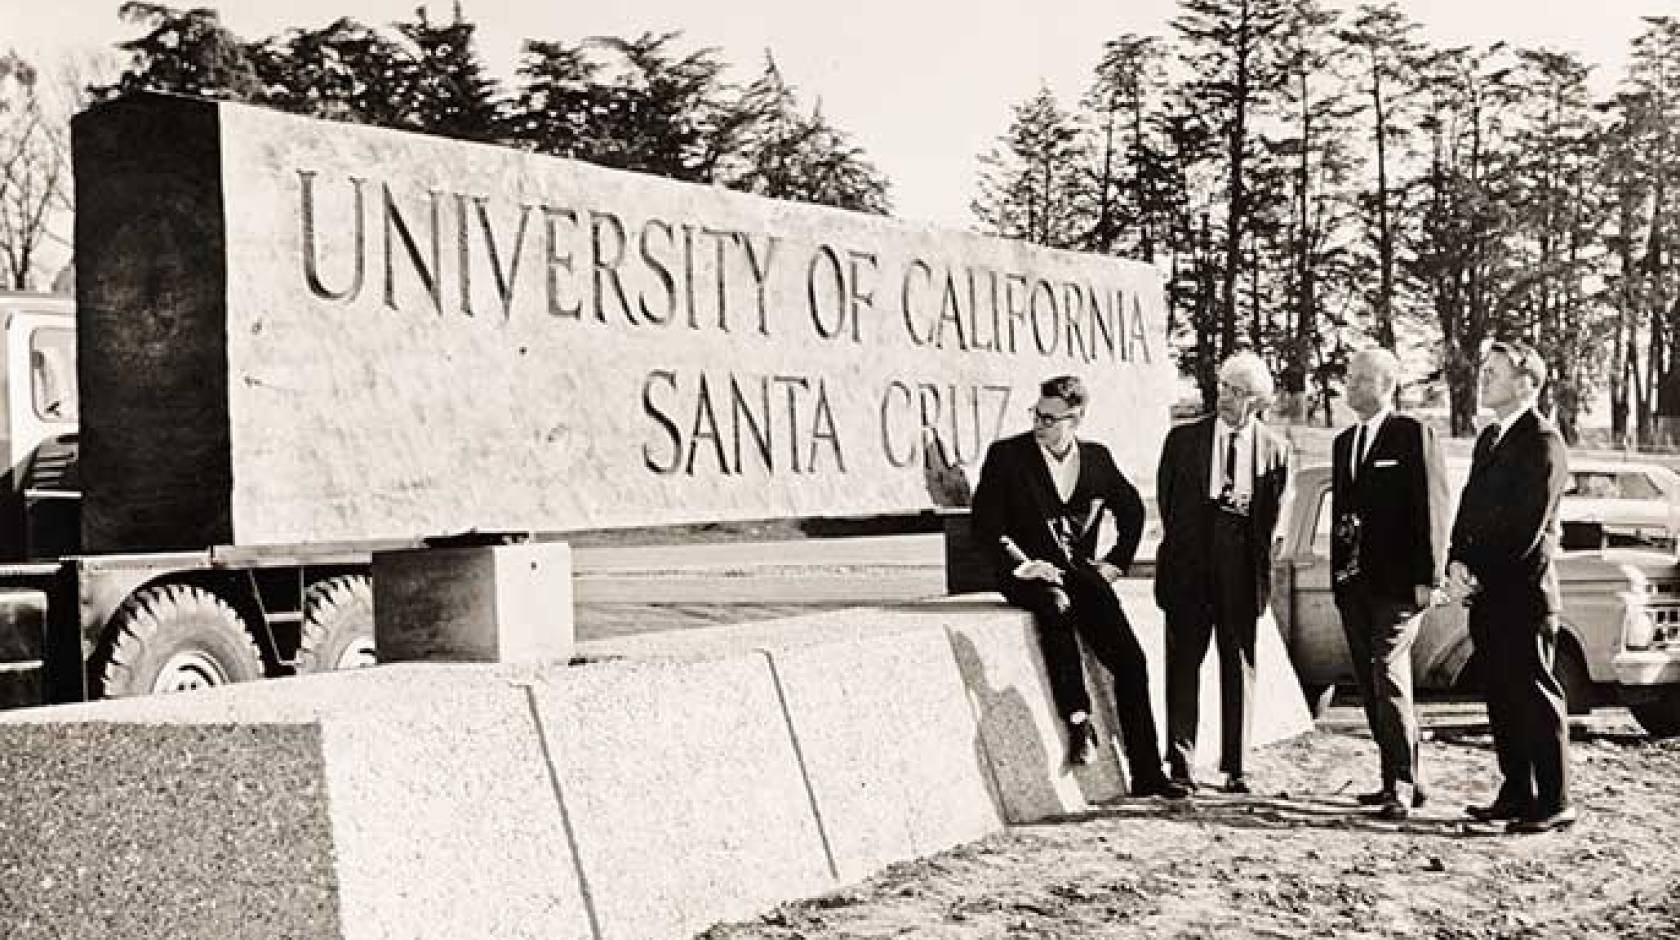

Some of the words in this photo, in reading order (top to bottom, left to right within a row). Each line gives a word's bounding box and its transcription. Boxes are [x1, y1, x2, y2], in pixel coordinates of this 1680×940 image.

[296, 168, 783, 336] UNIVERSITY
[807, 244, 878, 344] OF
[902, 258, 1152, 364] CALIFORNIA
[641, 369, 847, 476] SANTA
[880, 380, 1011, 470] CRUZ
